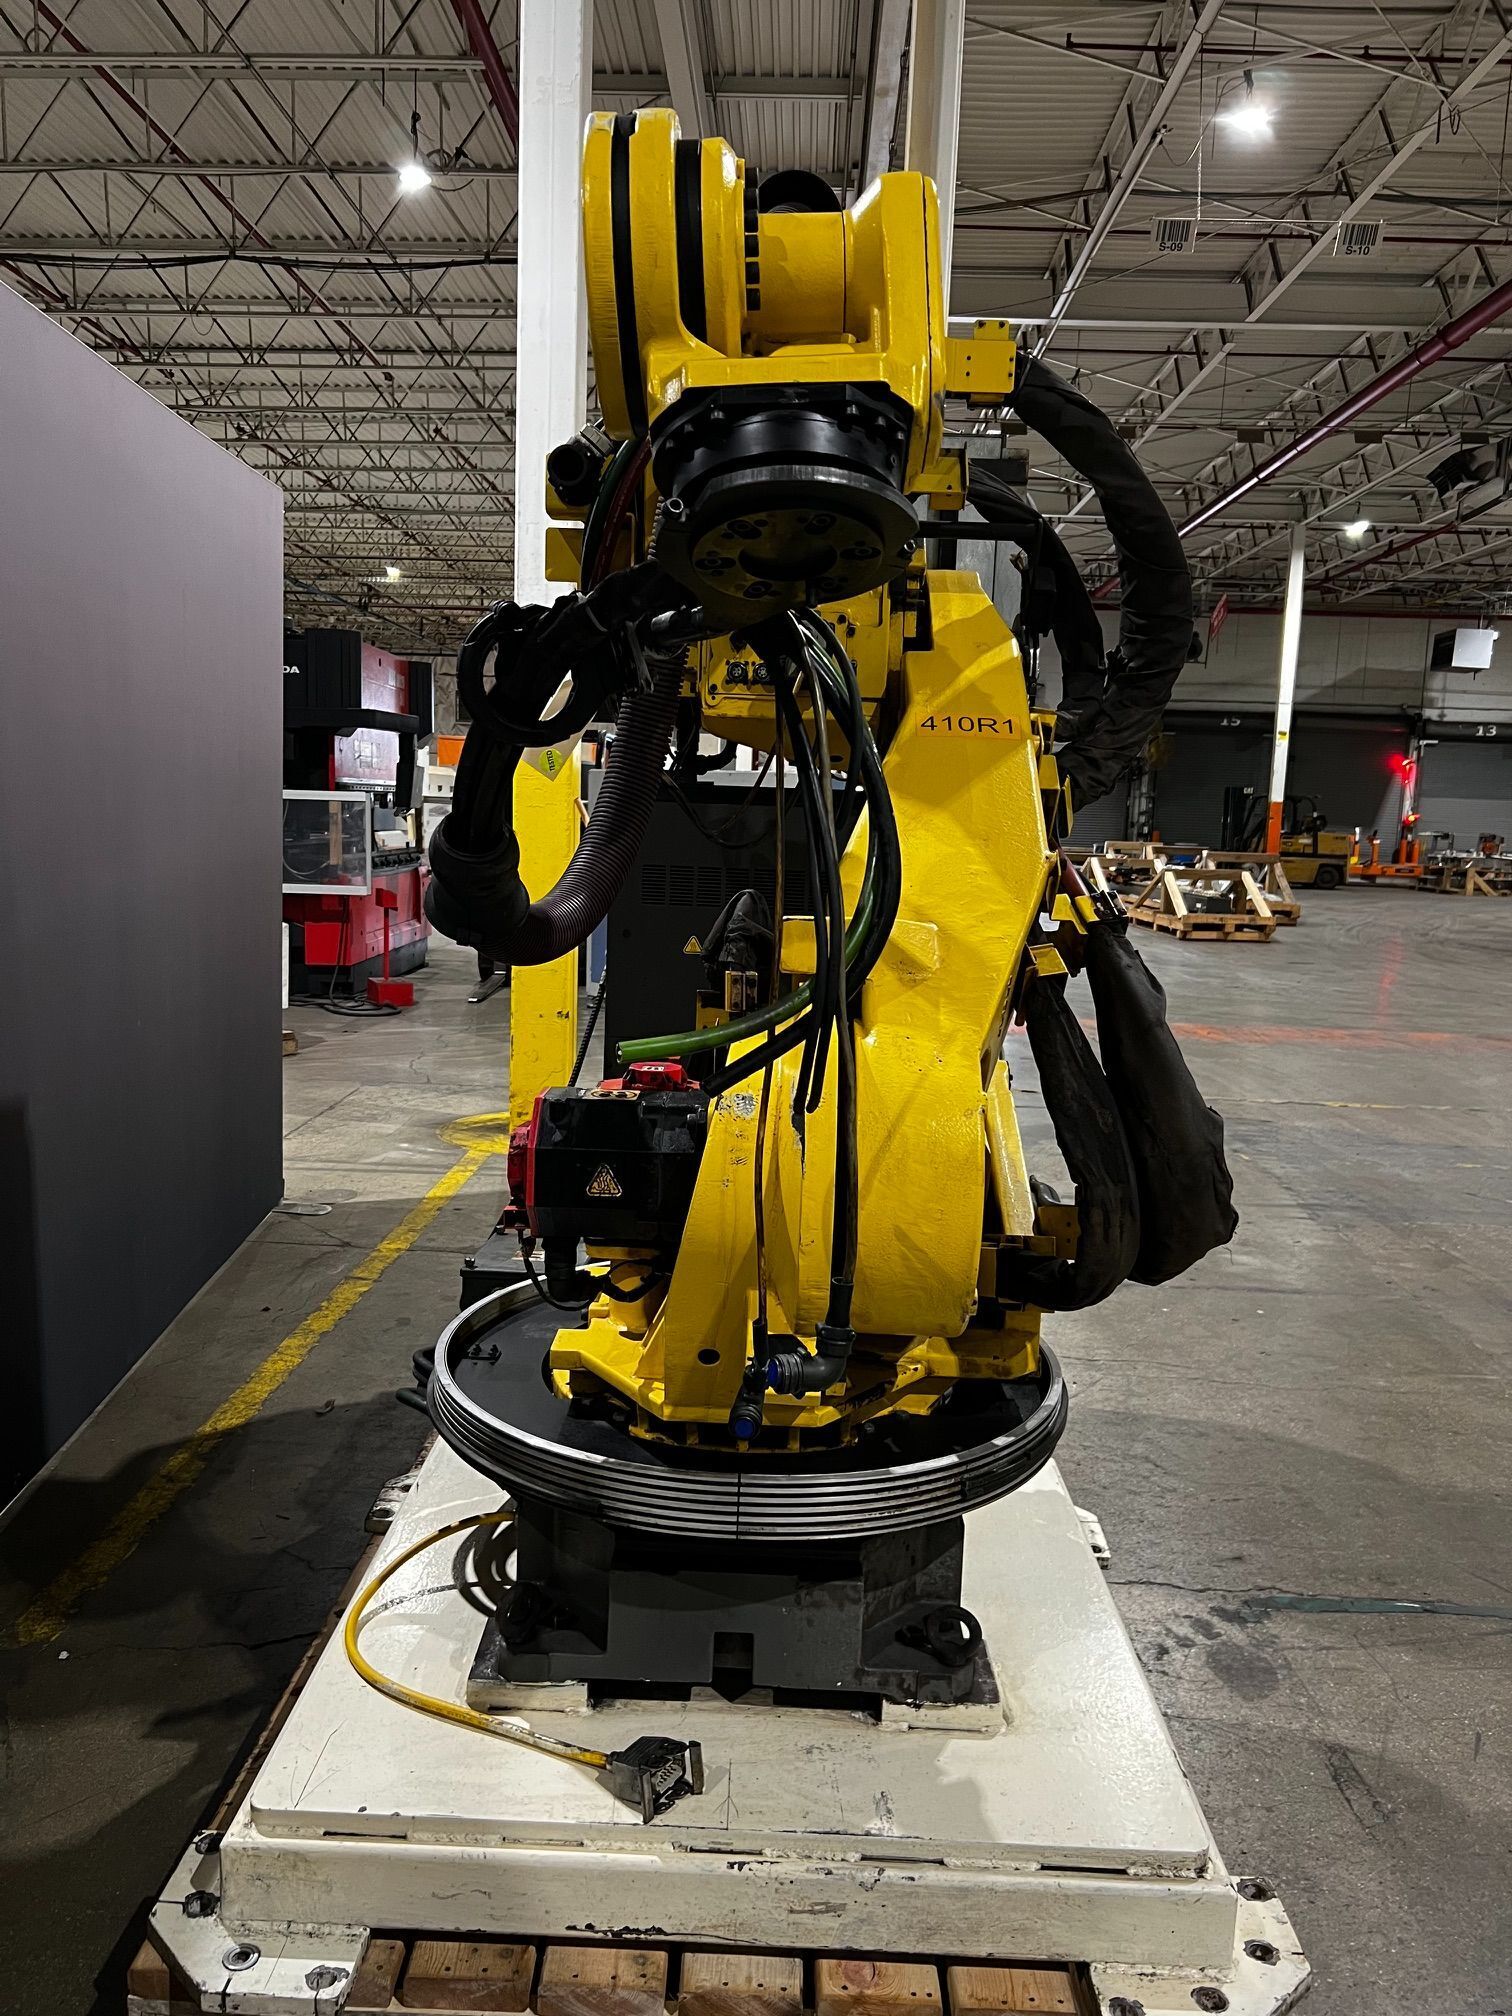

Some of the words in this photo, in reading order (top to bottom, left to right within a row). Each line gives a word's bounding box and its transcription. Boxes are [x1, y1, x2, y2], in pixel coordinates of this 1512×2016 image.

[1159, 241, 1183, 252] S-09
[1345, 245, 1370, 256] S-10
[920, 716, 1013, 734] 410R1
[1475, 725, 1497, 737] 13
[546, 750, 556, 772] TESTED
[1243, 786, 1254, 795] CAT
